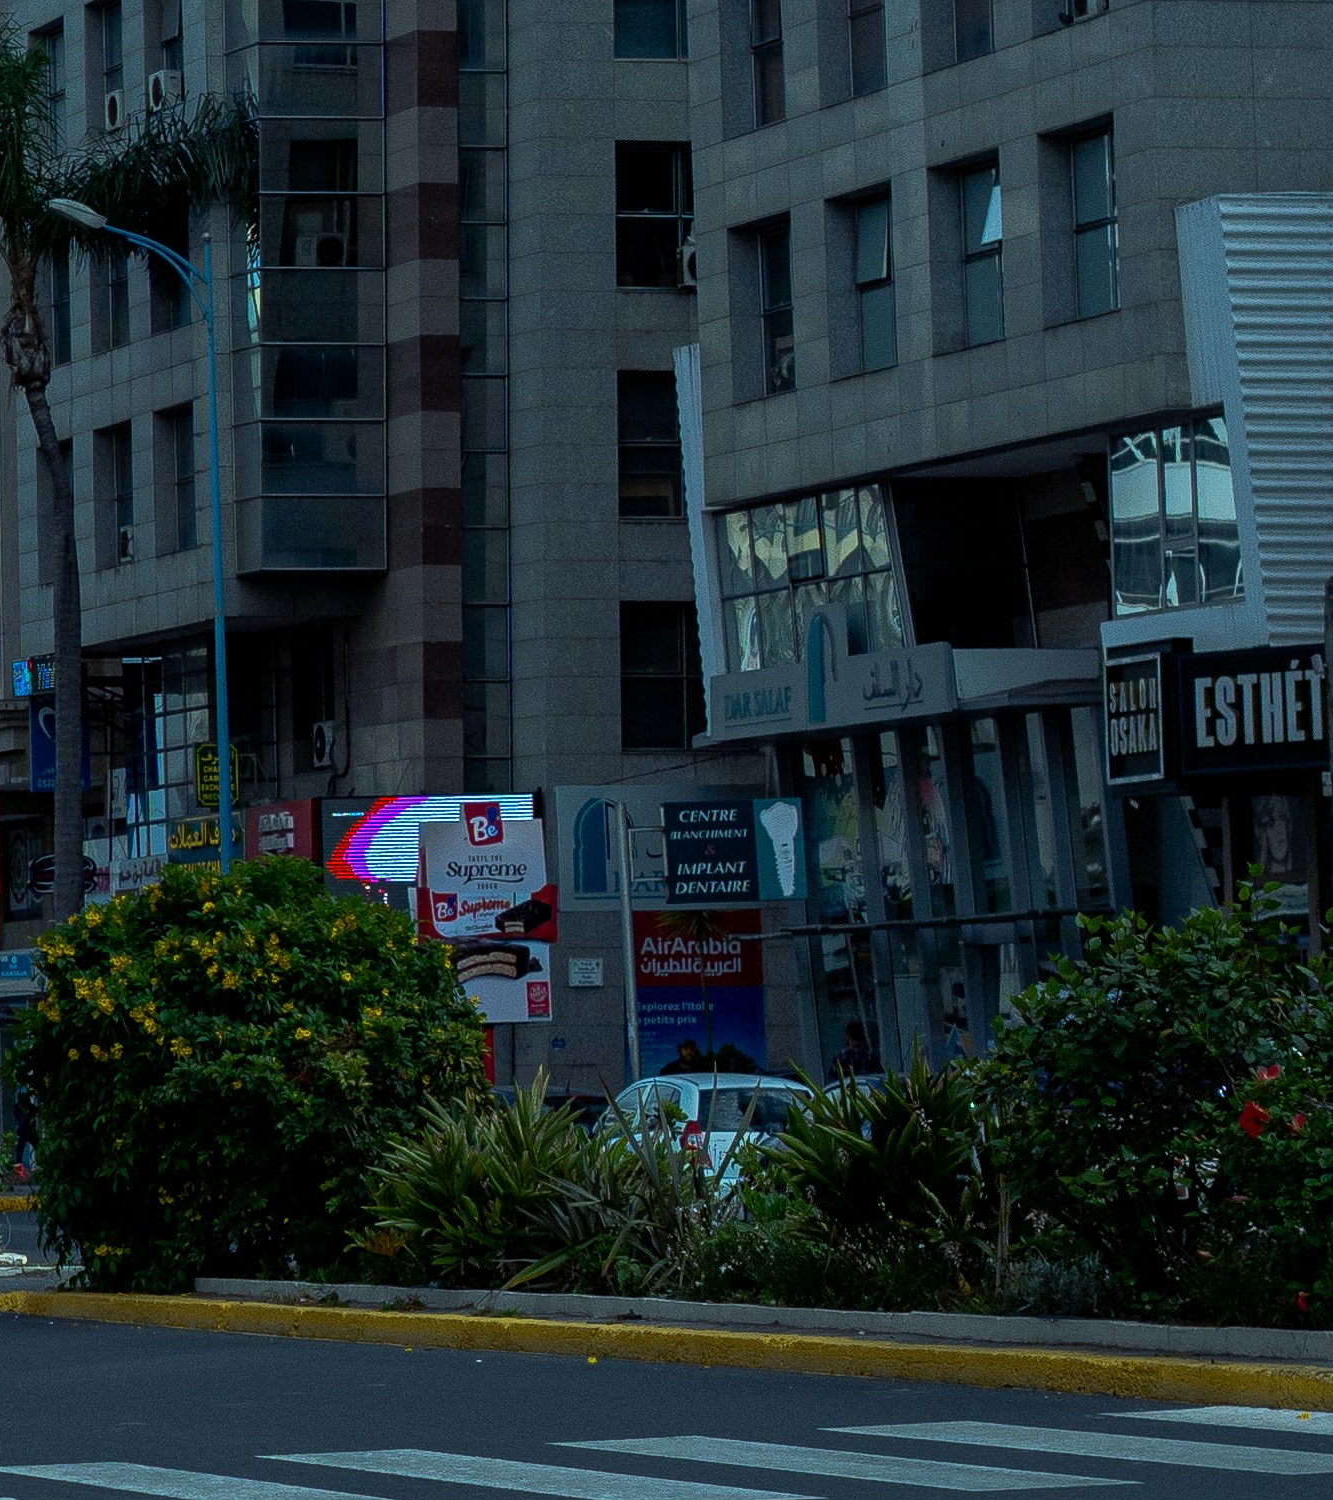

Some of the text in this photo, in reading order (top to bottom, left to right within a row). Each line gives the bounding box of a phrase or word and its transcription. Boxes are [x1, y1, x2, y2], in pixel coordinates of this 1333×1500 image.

[1109, 678, 1157, 713] SALON
[1110, 712, 1158, 757] OSAKA
[679, 809, 738, 823] CENTRE
[469, 815, 498, 841] Be
[670, 828, 748, 840] BLANCHIMENT
[704, 844, 716, 855] &
[446, 860, 527, 881] Supreme
[677, 861, 746, 876] IMPLANT
[675, 880, 751, 895] DENTAIRE
[643, 1015, 697, 1026] petits prix
